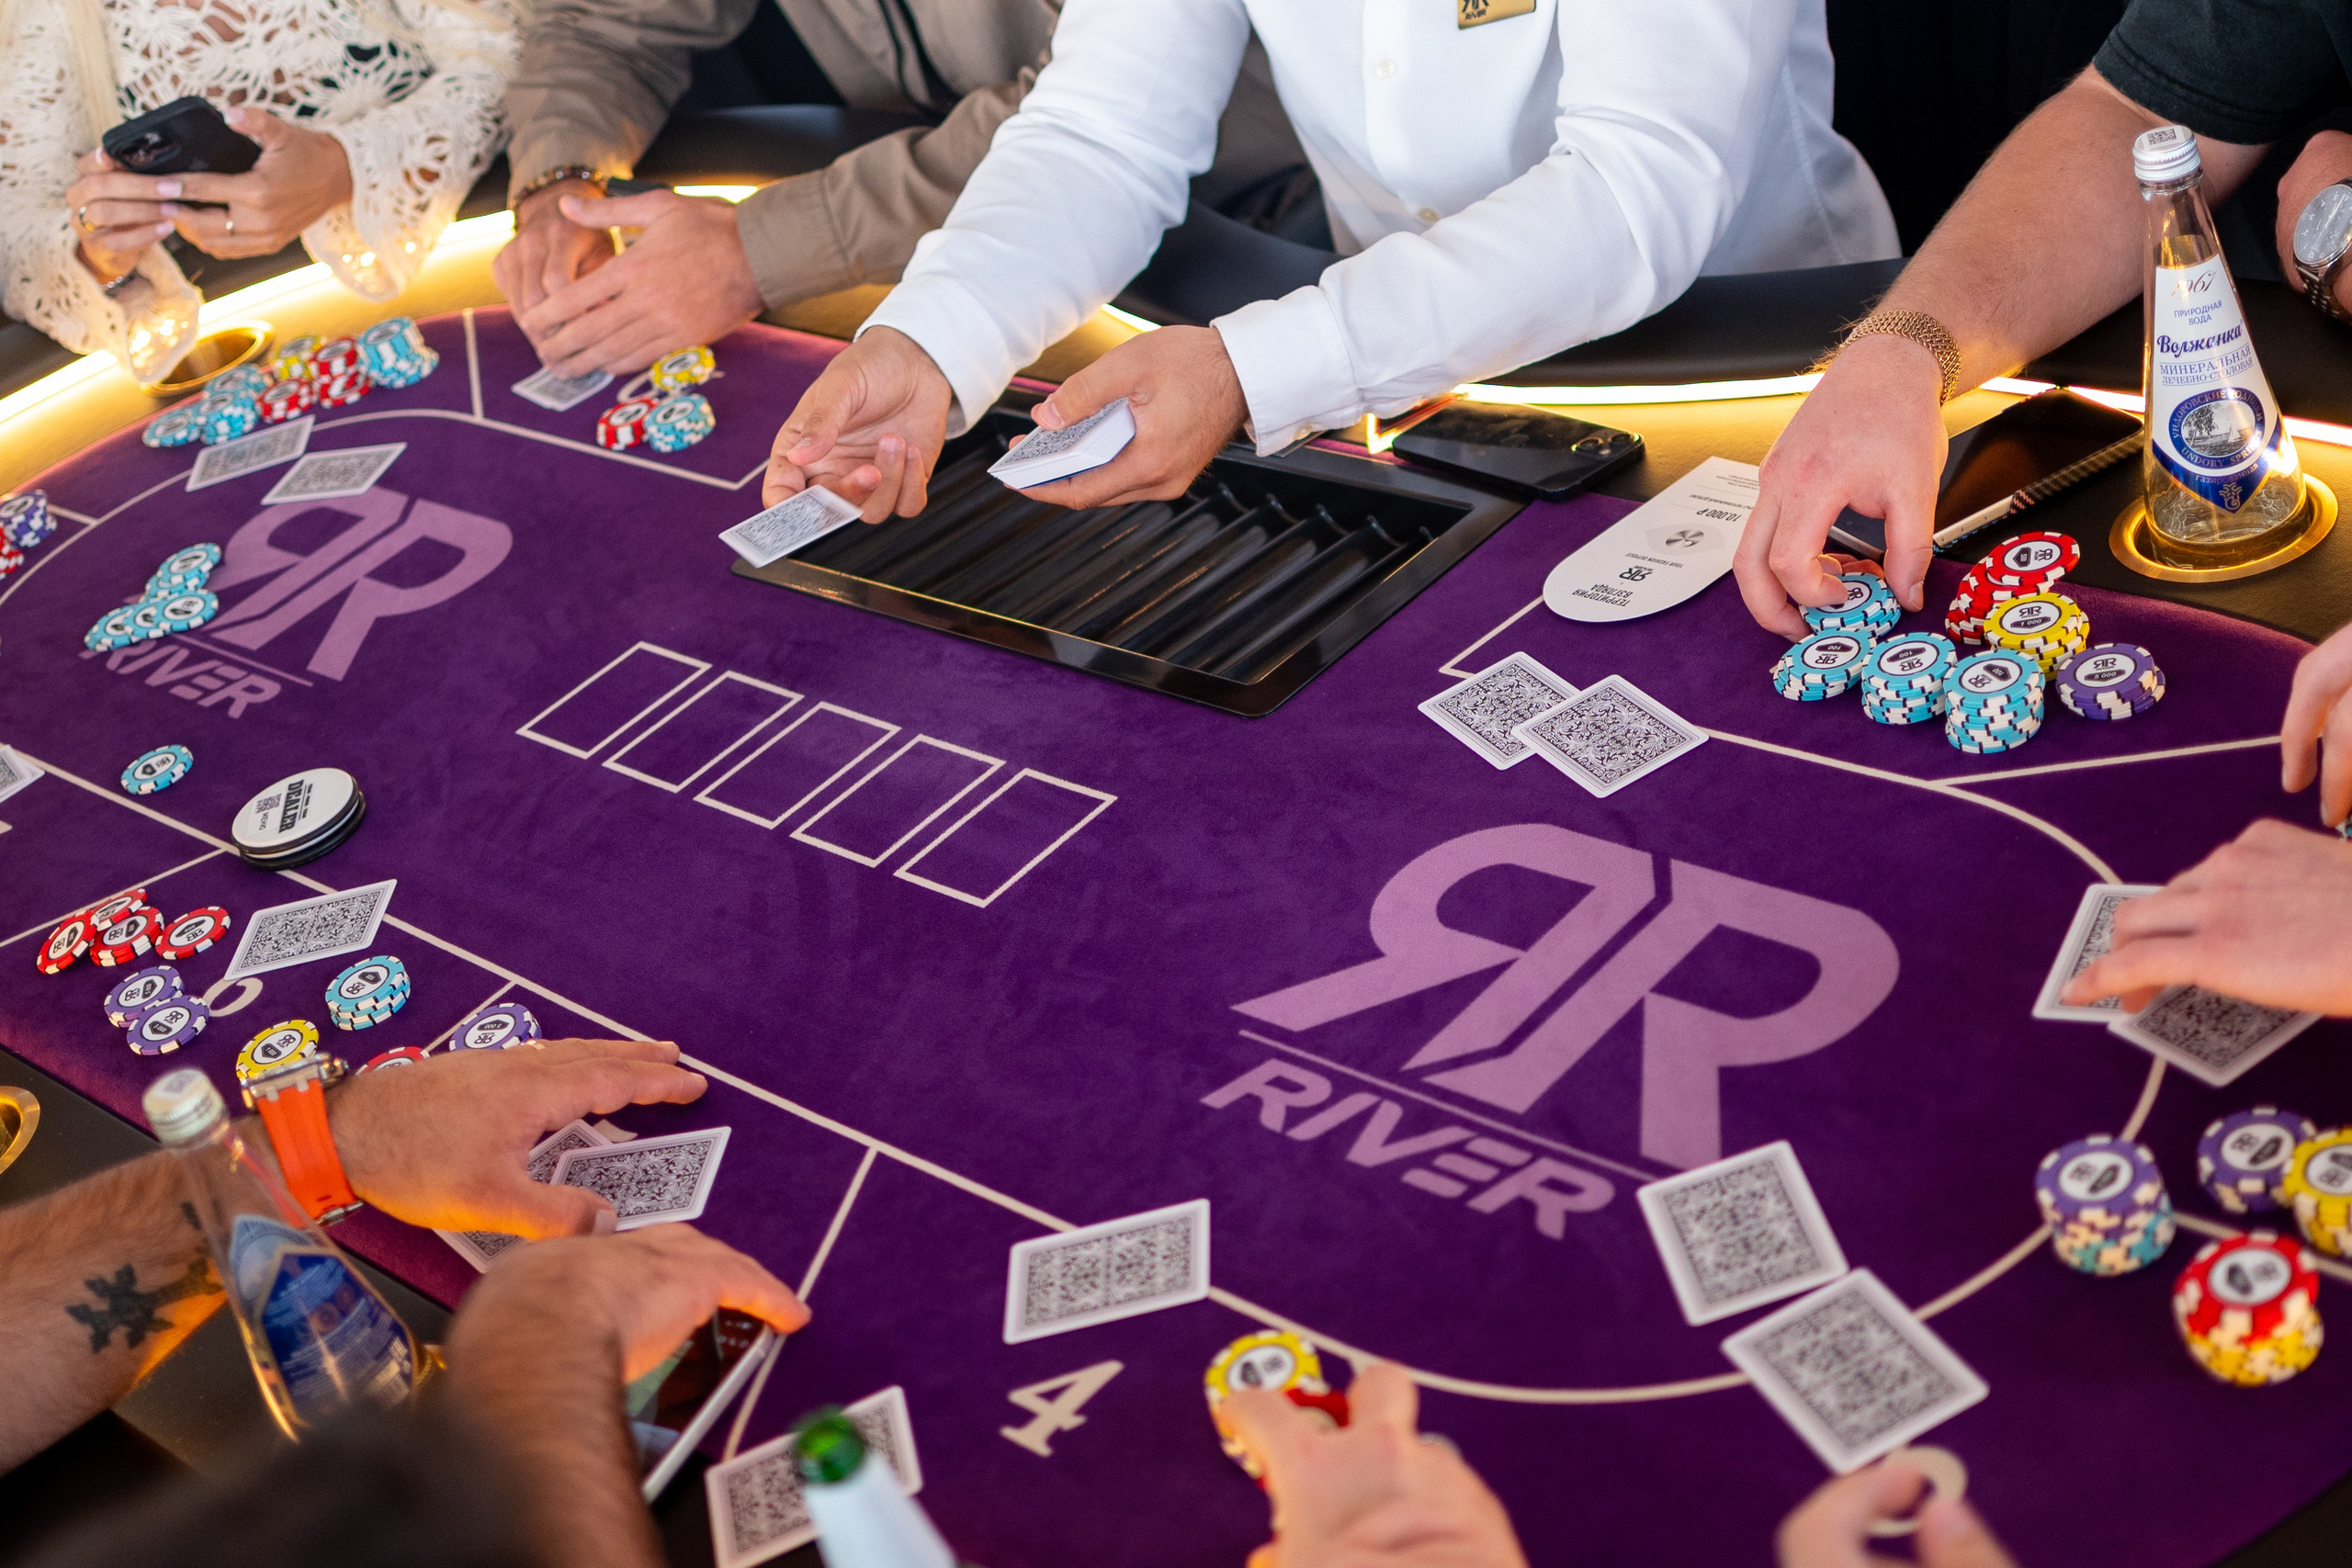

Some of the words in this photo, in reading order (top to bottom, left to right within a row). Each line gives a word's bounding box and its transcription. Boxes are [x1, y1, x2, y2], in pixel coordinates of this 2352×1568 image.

[2174, 299, 2223, 318] ПРИРОДНАЯ
[2188, 314, 2212, 325] ВОДА
[2156, 323, 2242, 358] Волжанка
[2160, 344, 2252, 375] МИНЕРАЛЬНАЯ
[2162, 356, 2254, 385] ЛЕЧЕБНО-СТОЛОВАЯ
[2230, 389, 2264, 422] ОДНИКИ
[2181, 446, 2225, 468] UNDORY
[2195, 462, 2260, 485] газированная
[1705, 509, 1742, 523] 10.000
[1572, 588, 1631, 607] ТЕРРИТОРИЯ
[1590, 583, 1634, 599] ВЗГЛЯДА
[278, 779, 305, 834] DEALER
[1199, 1058, 1616, 1242] RIVER
[999, 1359, 1125, 1459] 4
